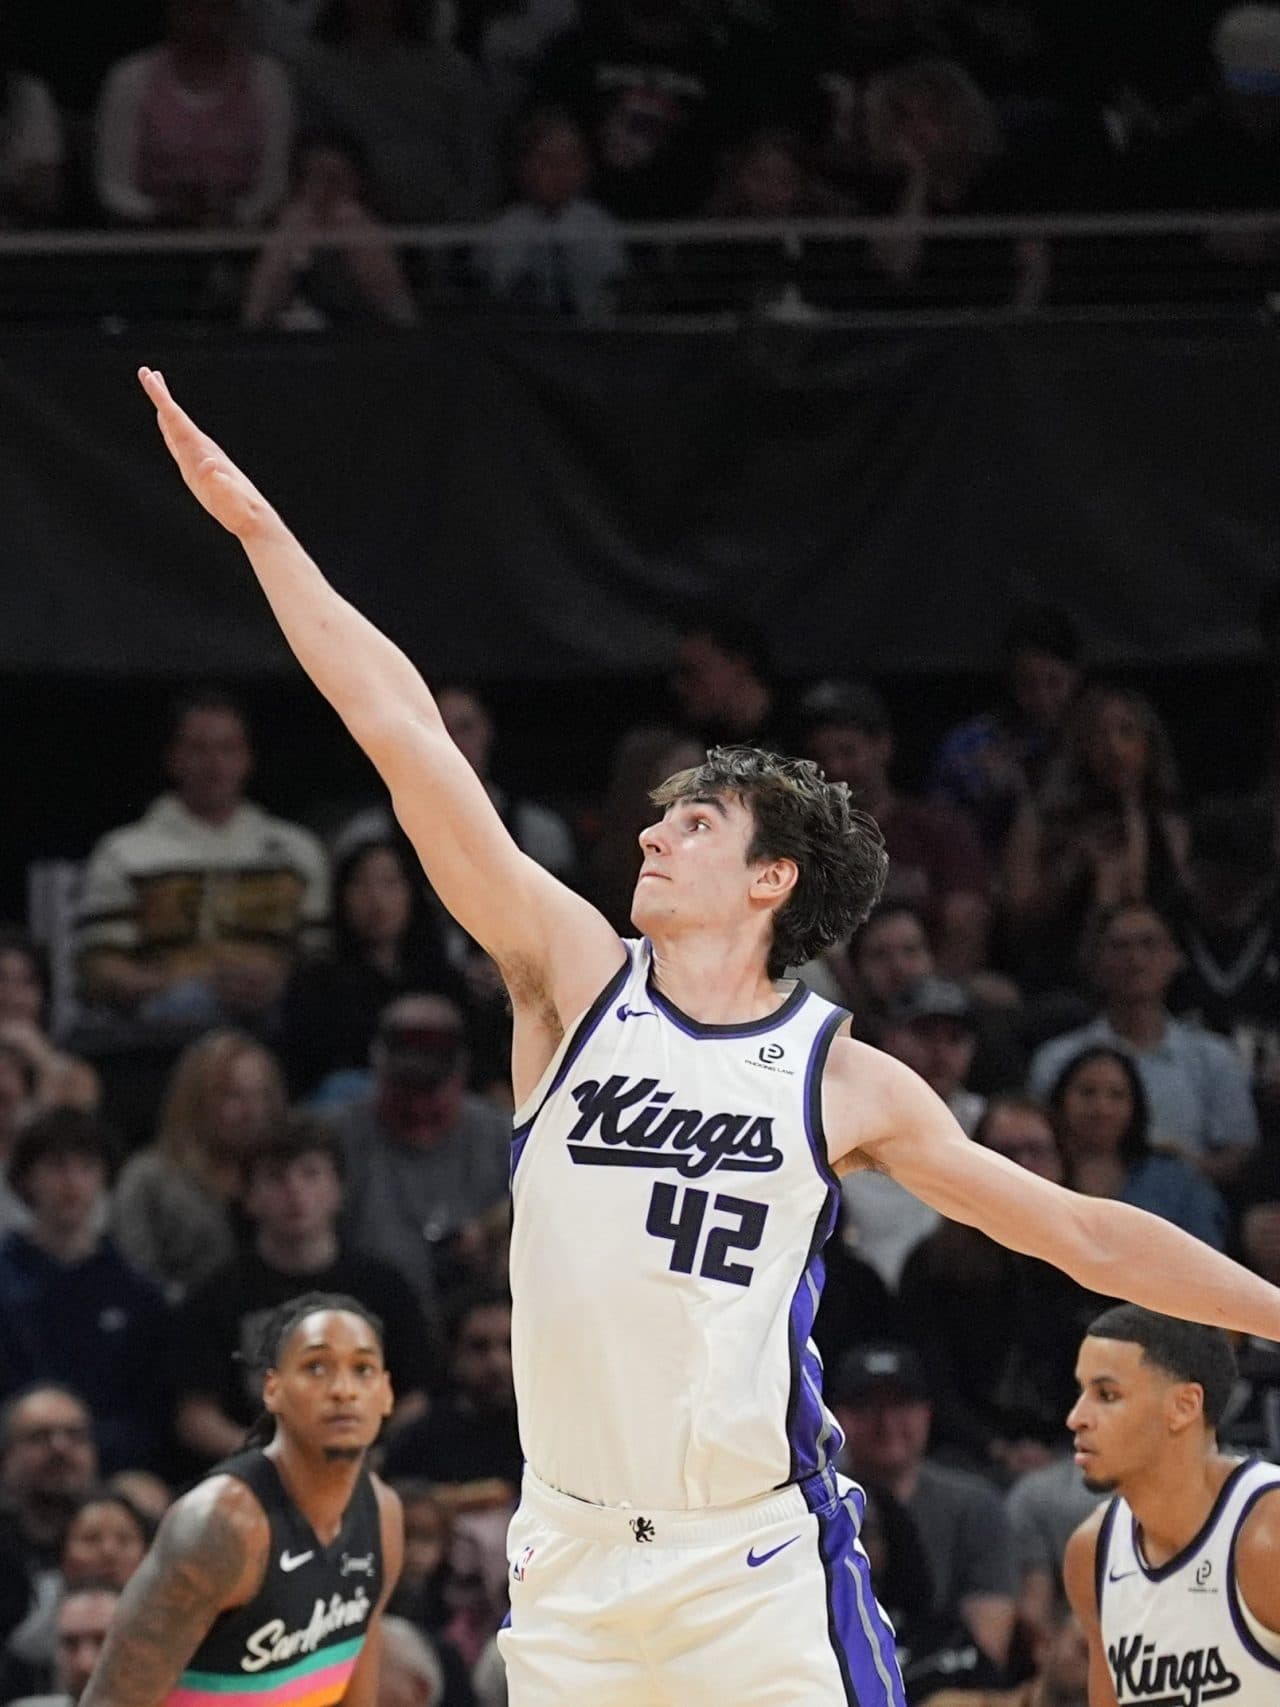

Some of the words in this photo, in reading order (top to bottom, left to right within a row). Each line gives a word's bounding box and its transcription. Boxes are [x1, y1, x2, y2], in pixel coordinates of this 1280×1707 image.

[566, 1074, 784, 1178] Kings
[645, 1181, 770, 1287] 42
[1108, 1633, 1241, 1707] Kings
